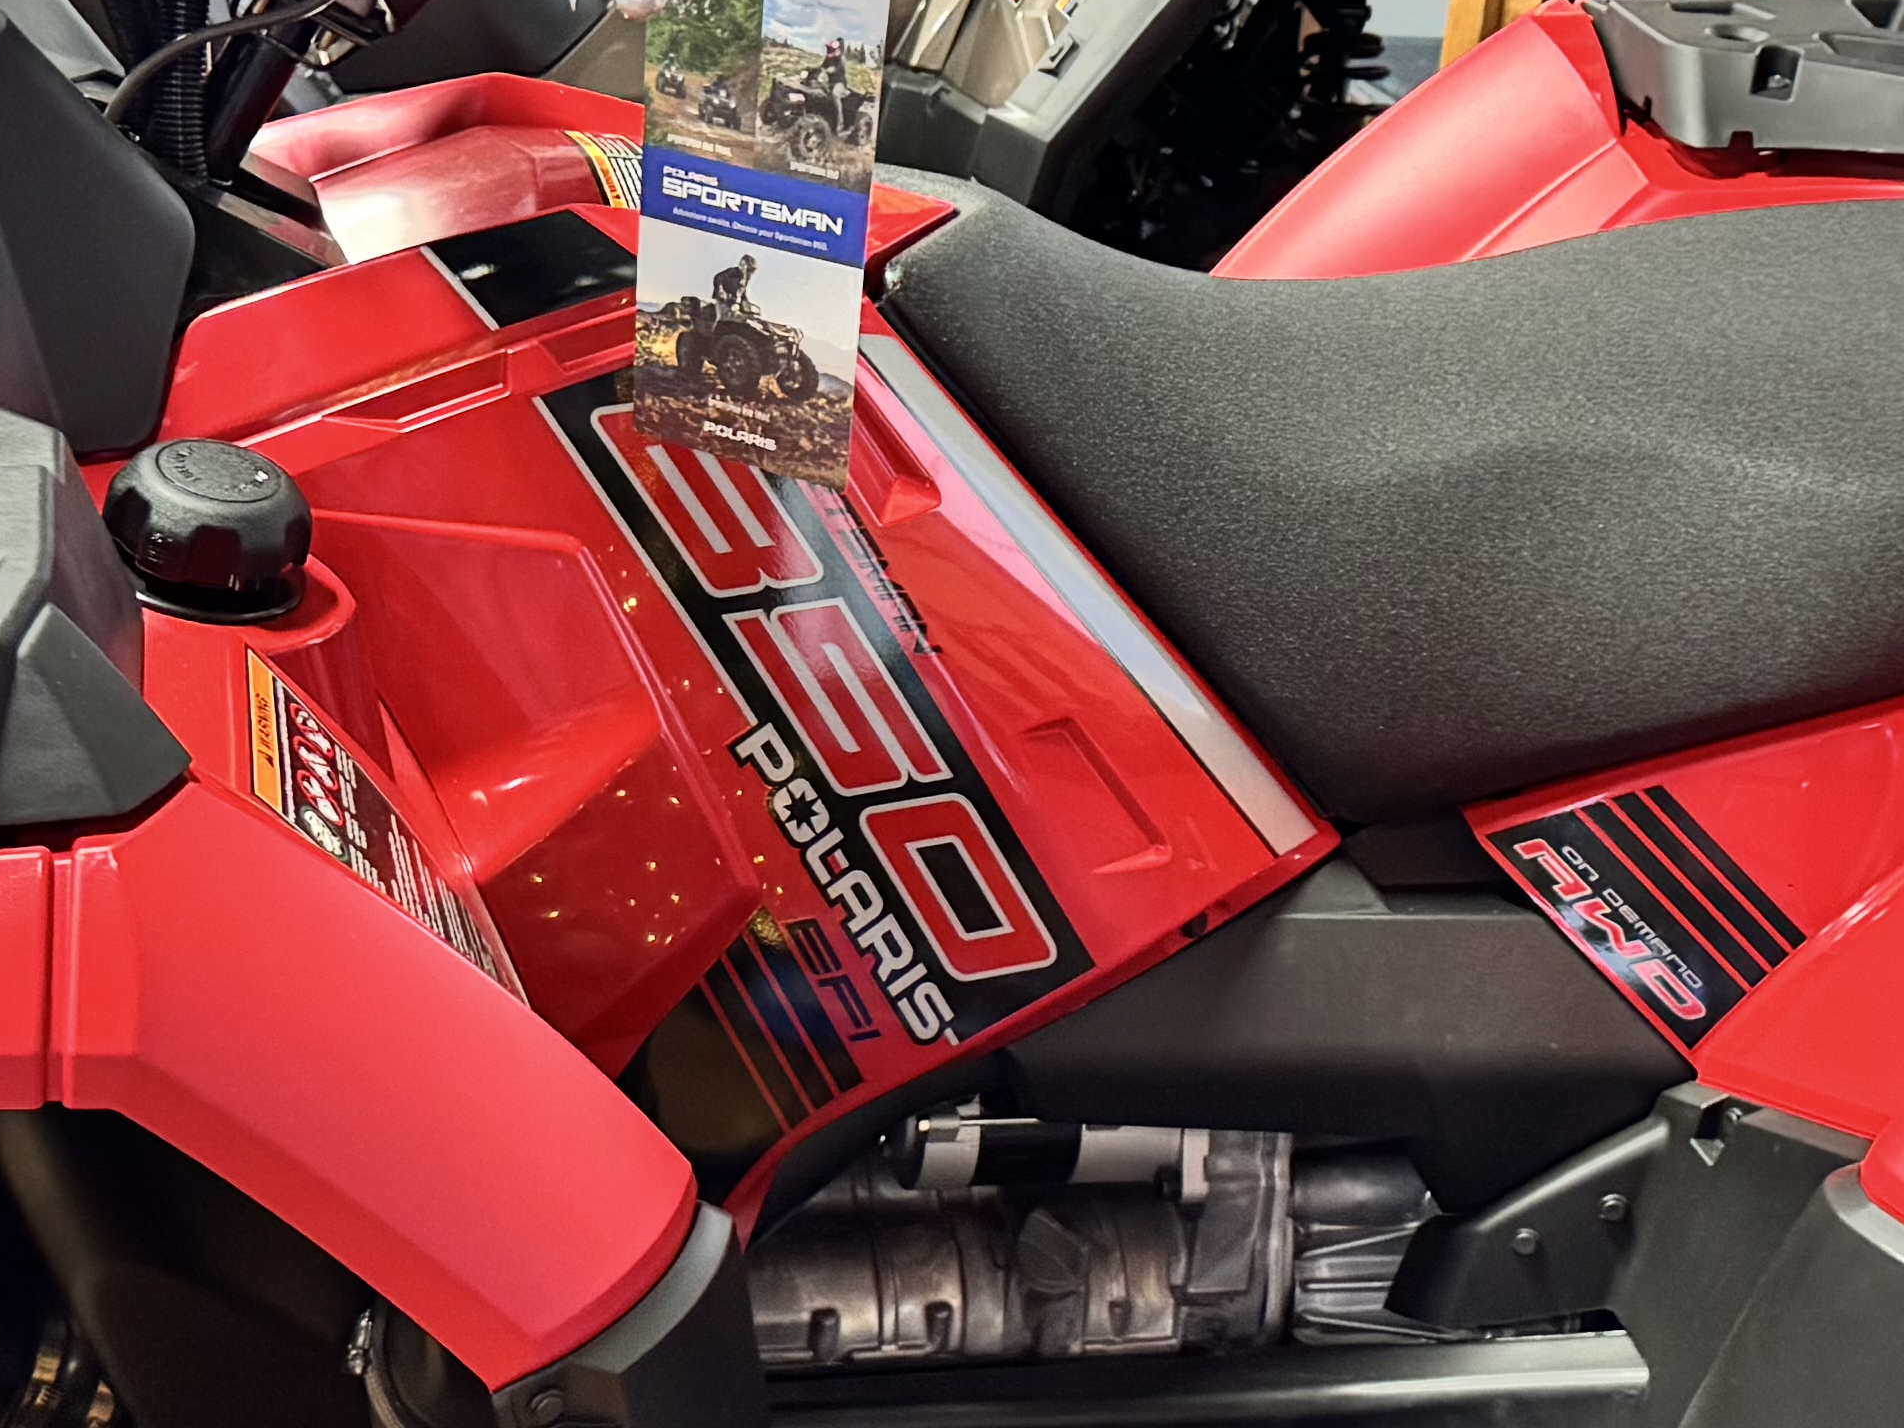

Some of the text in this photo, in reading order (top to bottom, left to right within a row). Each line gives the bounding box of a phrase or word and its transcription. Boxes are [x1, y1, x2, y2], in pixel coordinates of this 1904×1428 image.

[662, 176, 844, 237] SPORTSMAN
[663, 165, 719, 187] POLARIS
[703, 420, 777, 452] POLARIS
[591, 400, 1057, 984] 850
[734, 723, 957, 1045] POLARIS
[1512, 837, 1707, 1021] AWD
[787, 918, 882, 1045] EFI
